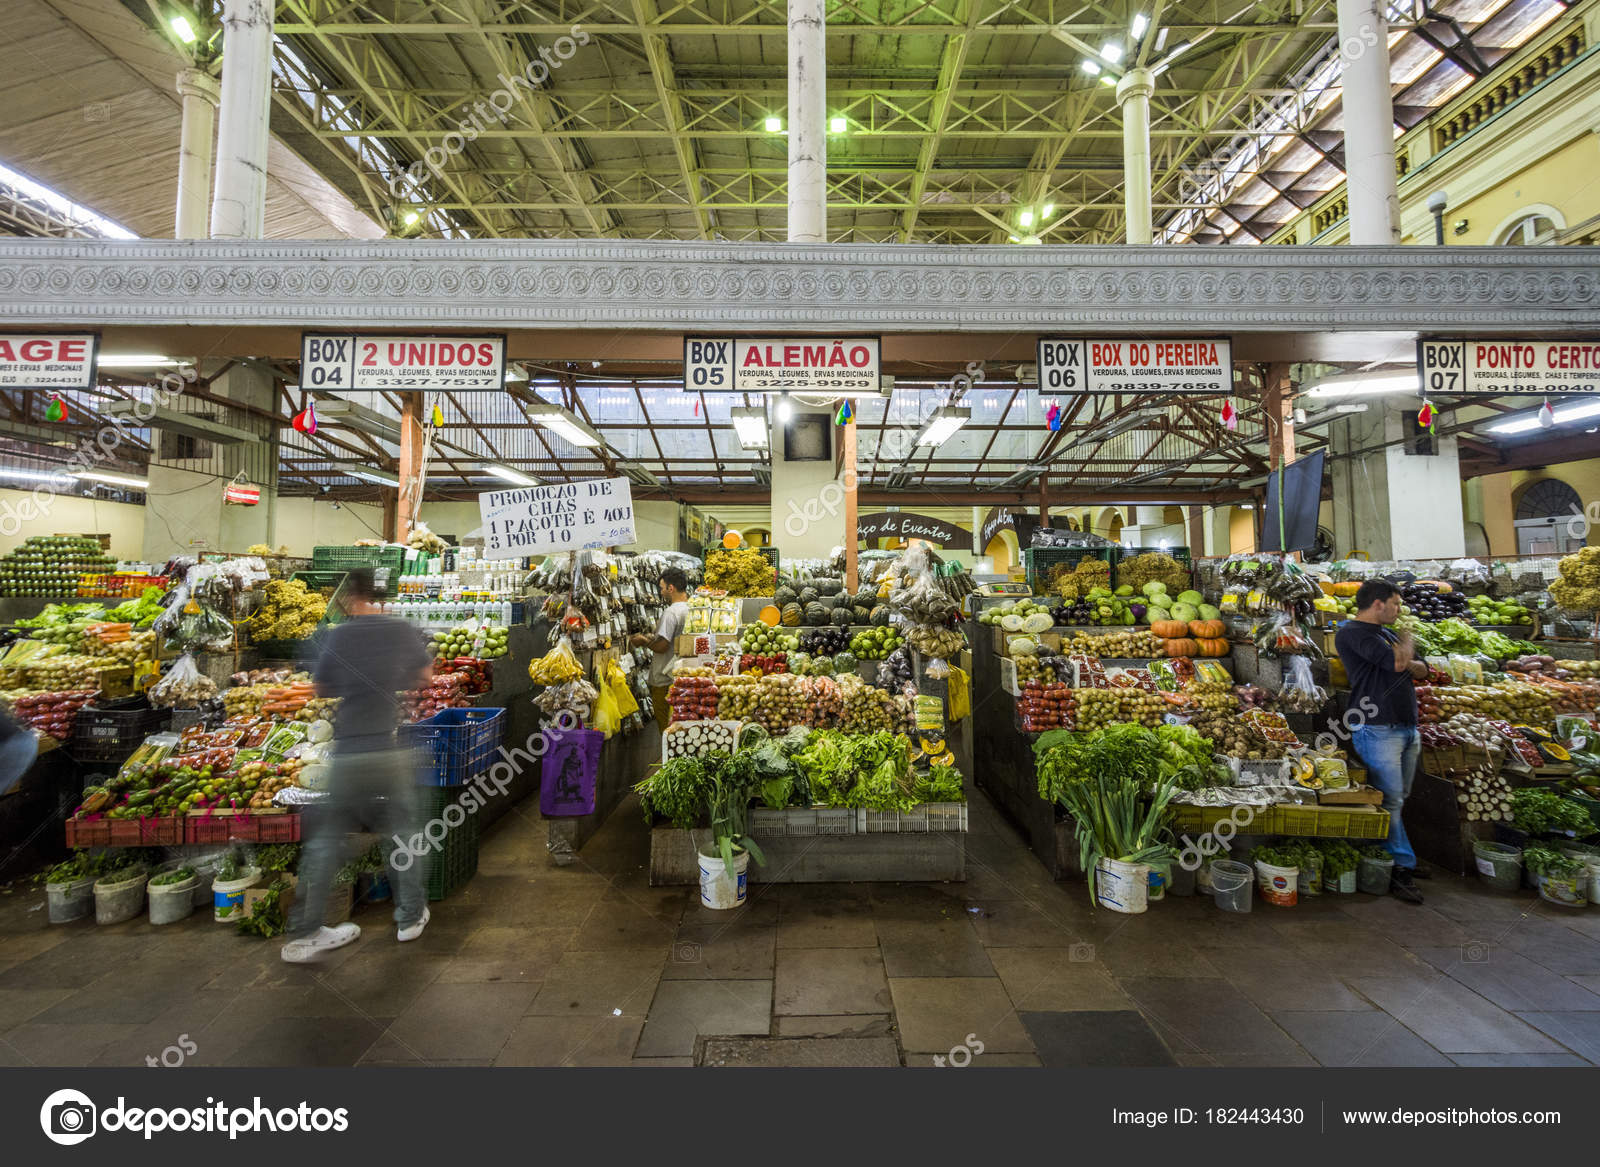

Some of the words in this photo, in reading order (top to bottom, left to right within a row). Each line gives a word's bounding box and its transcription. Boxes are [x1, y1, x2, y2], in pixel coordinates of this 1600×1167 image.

[309, 339, 347, 363] BOX
[362, 343, 378, 366] 2
[388, 343, 494, 367] UNIDOS
[691, 341, 728, 365] BOX
[743, 340, 870, 368] ALEMÃO
[1043, 343, 1080, 367] BOX
[1092, 343, 1123, 367] BOX
[1129, 343, 1150, 367] DO
[1156, 343, 1219, 366] PEREIRA
[1426, 345, 1461, 369] BOX
[1476, 345, 1535, 369] PONTO
[1547, 346, 1600, 369] CERTO
[311, 366, 343, 385] 04
[357, 369, 395, 377] VERDURAS,
[399, 368, 432, 377] LEGUMES,
[376, 378, 494, 386] 3327-7537
[693, 367, 724, 386] 05
[738, 370, 775, 378] VERDURAS,
[778, 370, 811, 378] LEGUMES,
[1048, 369, 1076, 388] 06
[1093, 369, 1129, 377] VERDURAS,
[1430, 372, 1459, 390] 07
[1473, 371, 1509, 379] VERDURAS,
[756, 379, 870, 387] 3225-9959
[1487, 384, 1595, 392] 9198-0040
[489, 484, 577, 507] PROMOCAO
[588, 481, 612, 497] DE
[528, 498, 577, 517] CHAS
[490, 520, 497, 534] 1
[504, 513, 576, 534] PACOTE
[880, 518, 898, 532] de
[901, 519, 953, 541] Eventos
[490, 536, 500, 549] 3
[507, 531, 537, 548] POR
